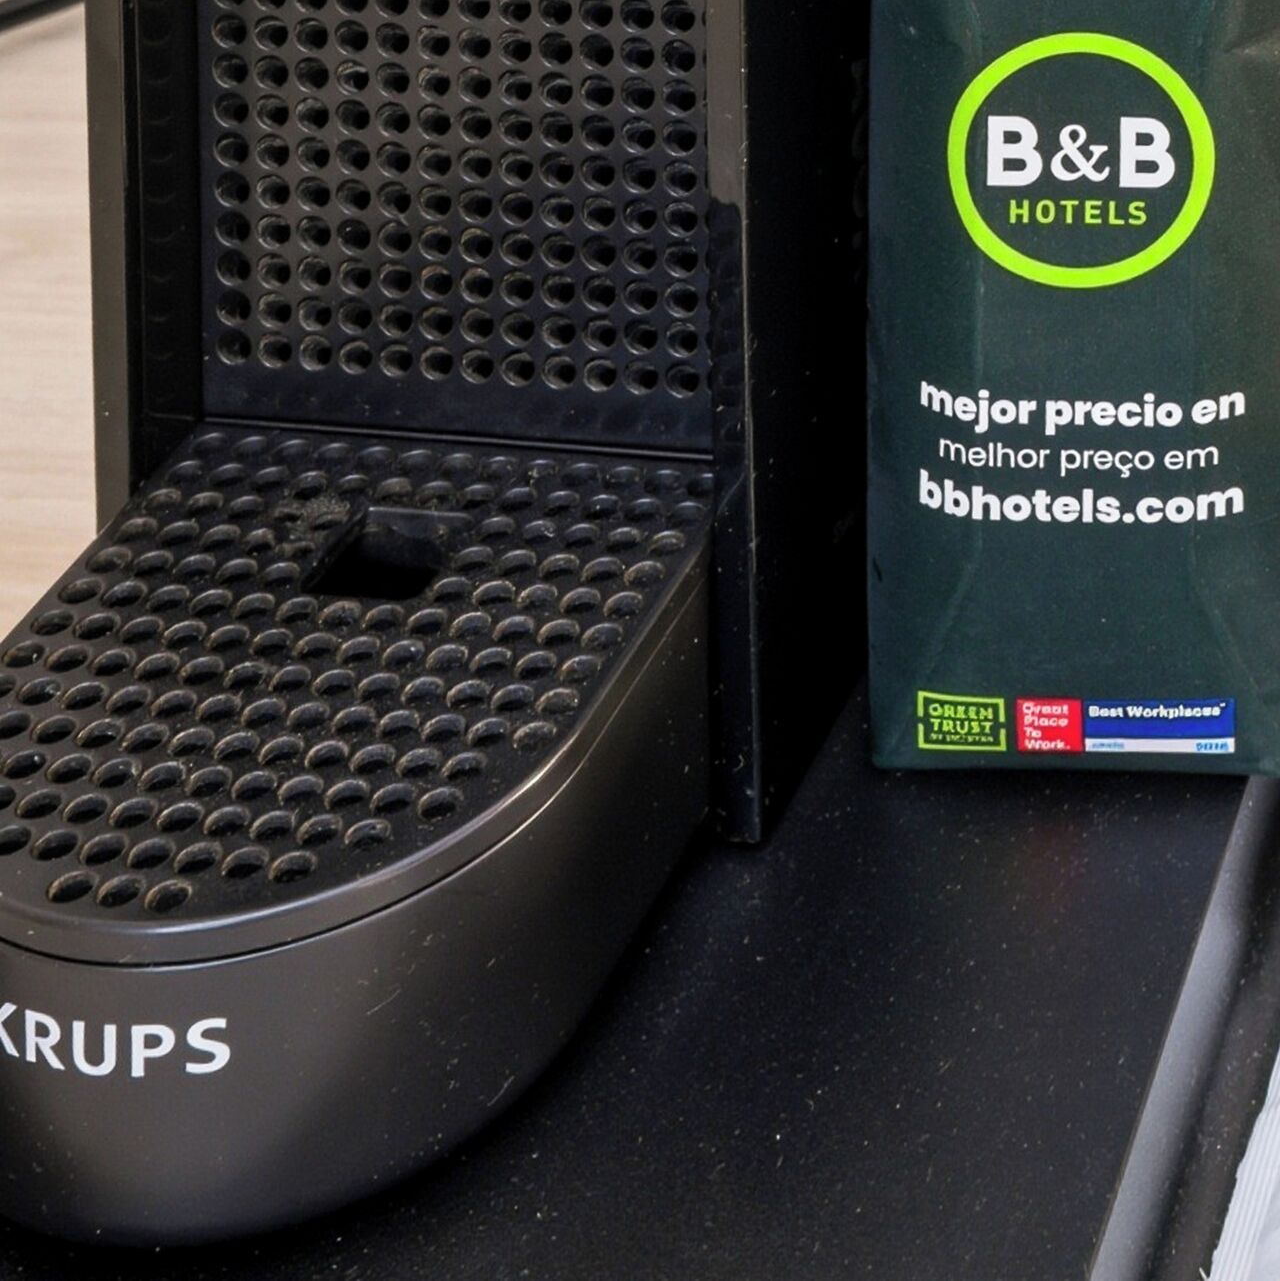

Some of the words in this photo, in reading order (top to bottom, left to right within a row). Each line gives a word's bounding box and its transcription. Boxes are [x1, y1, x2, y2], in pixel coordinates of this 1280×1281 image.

[986, 115, 1176, 188] B&B
[1008, 198, 1148, 226] HOTELS
[919, 379, 1037, 434] mejor
[1044, 392, 1183, 436] precio
[1191, 391, 1246, 425] en
[938, 437, 1050, 469] melhor
[1060, 443, 1156, 478] preço
[1163, 444, 1220, 470] em
[918, 469, 1245, 524] bbhotels.com
[929, 718, 994, 734] TRUST
